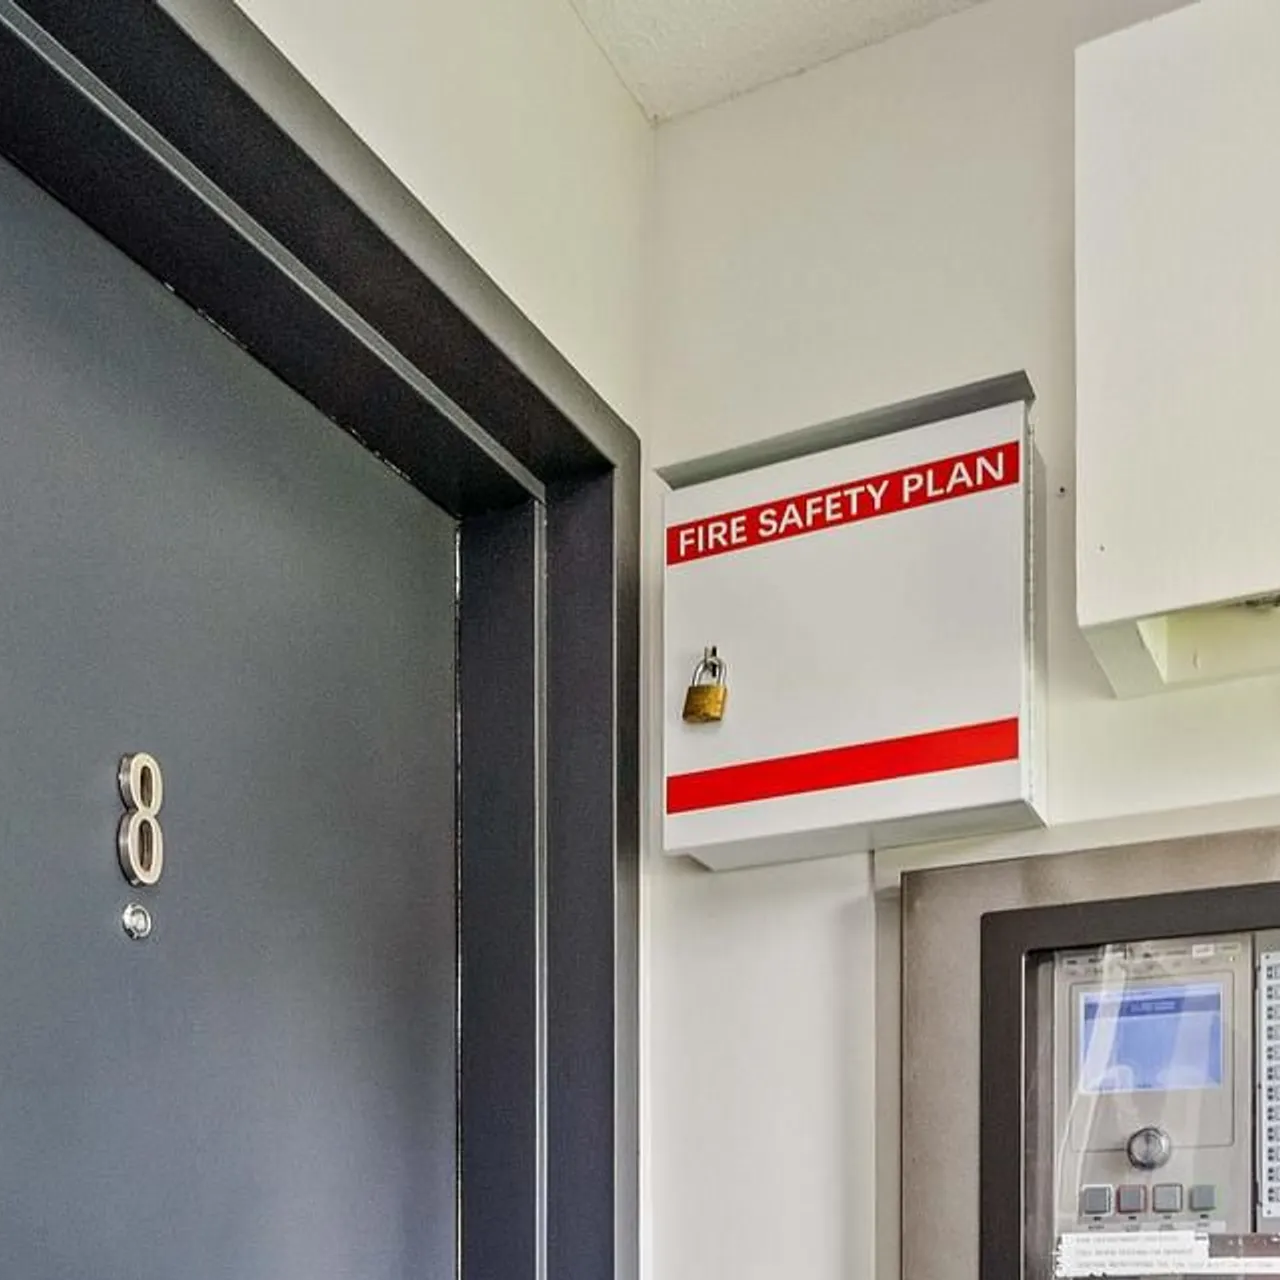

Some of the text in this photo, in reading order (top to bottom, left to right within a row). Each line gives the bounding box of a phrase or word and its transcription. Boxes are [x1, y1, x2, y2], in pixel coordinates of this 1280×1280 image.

[679, 451, 1005, 557] FIRE SAFETY PLAN
[118, 752, 163, 885] 8
